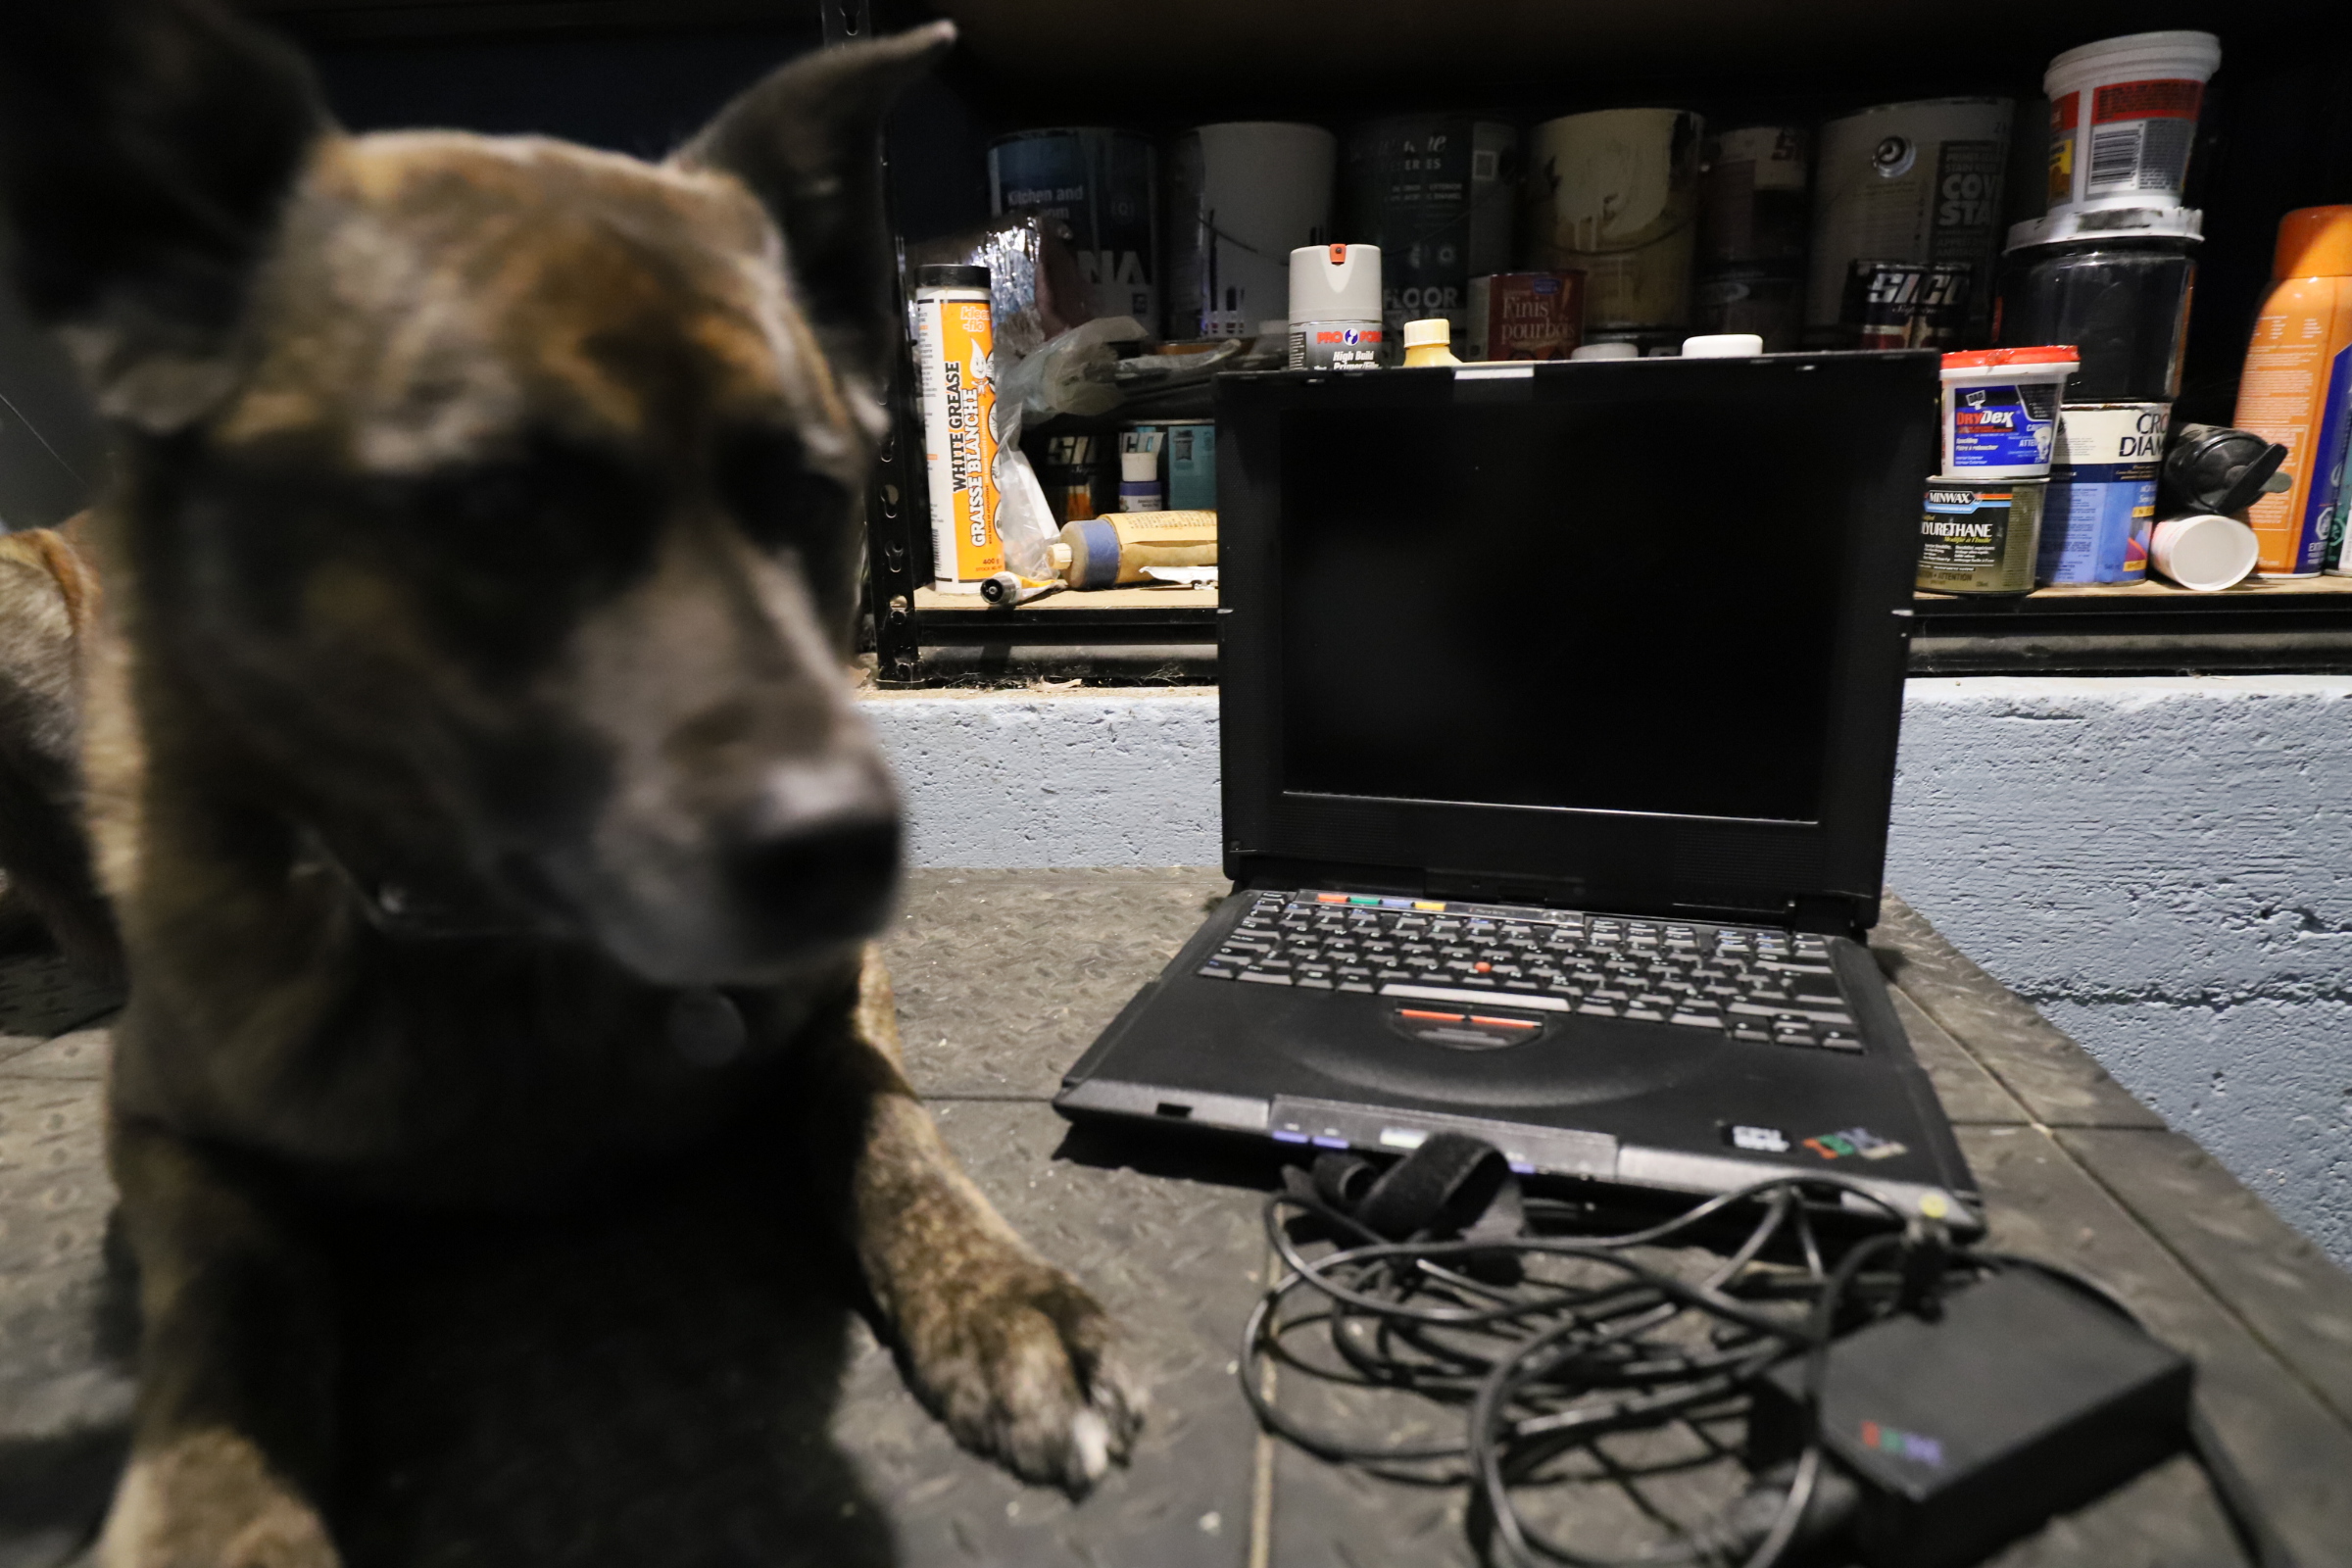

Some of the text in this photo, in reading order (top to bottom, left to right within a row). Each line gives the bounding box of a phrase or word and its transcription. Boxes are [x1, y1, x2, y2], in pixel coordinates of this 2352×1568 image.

[1007, 185, 1084, 206] Kitchen and
[1941, 173, 1999, 201] COV
[1936, 200, 1992, 226] STA
[1867, 273, 1971, 306] SICO
[1501, 295, 1548, 318] Finis
[1316, 331, 1344, 344] PRO
[1501, 318, 1575, 345] pour bois
[1333, 351, 1375, 363] High Build
[945, 362, 967, 493] WHITE GREASE
[2136, 413, 2170, 435] CRO
[2119, 435, 2166, 458] DIAM
[961, 388, 987, 547] GRAISSE BLANCHE
[1930, 492, 1971, 504] MINWAX
